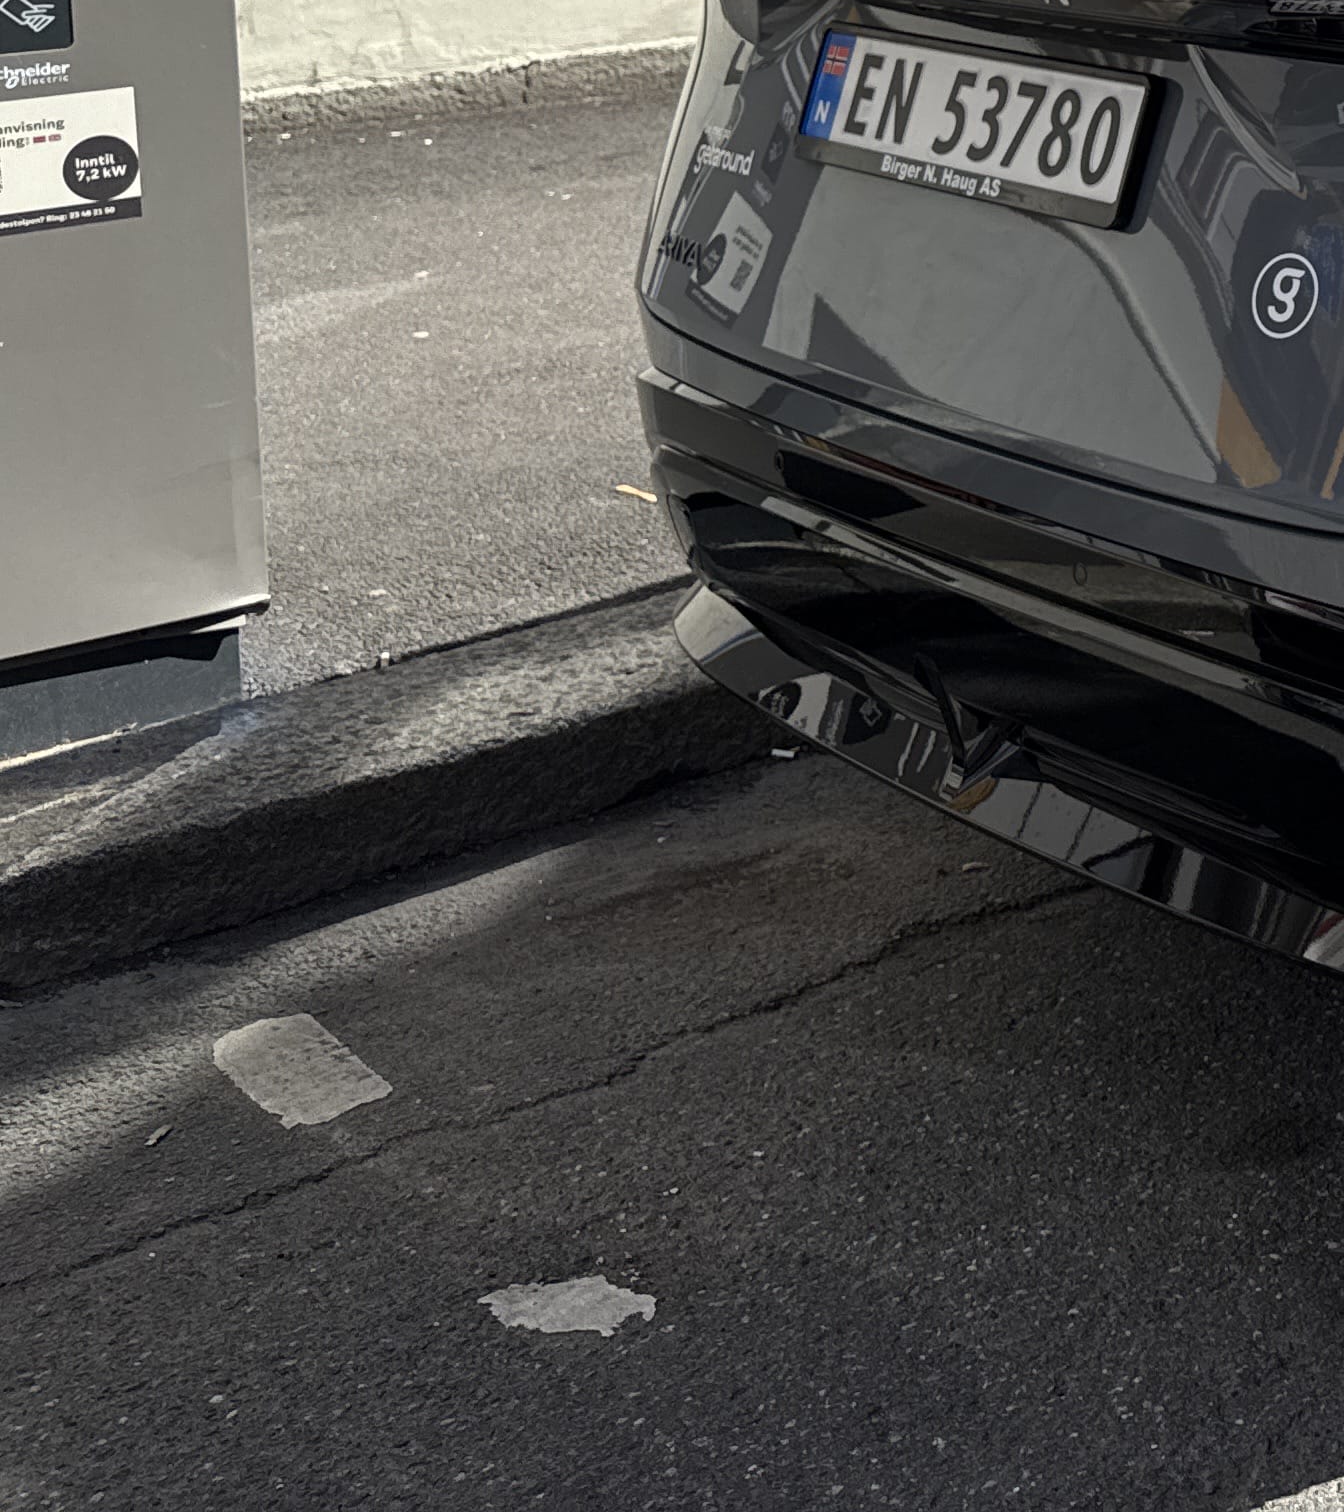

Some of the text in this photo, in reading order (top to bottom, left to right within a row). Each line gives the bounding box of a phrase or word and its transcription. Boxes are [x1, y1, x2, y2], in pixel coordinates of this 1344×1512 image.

[21, 74, 69, 86] Electric
[814, 53, 1121, 185] N EN 53780
[75, 153, 115, 169] Inntil
[75, 164, 127, 184] 7,2 kW
[693, 143, 755, 175] getaround
[880, 155, 1001, 198] Birger N. Haug AS
[1267, 267, 1305, 322] g
